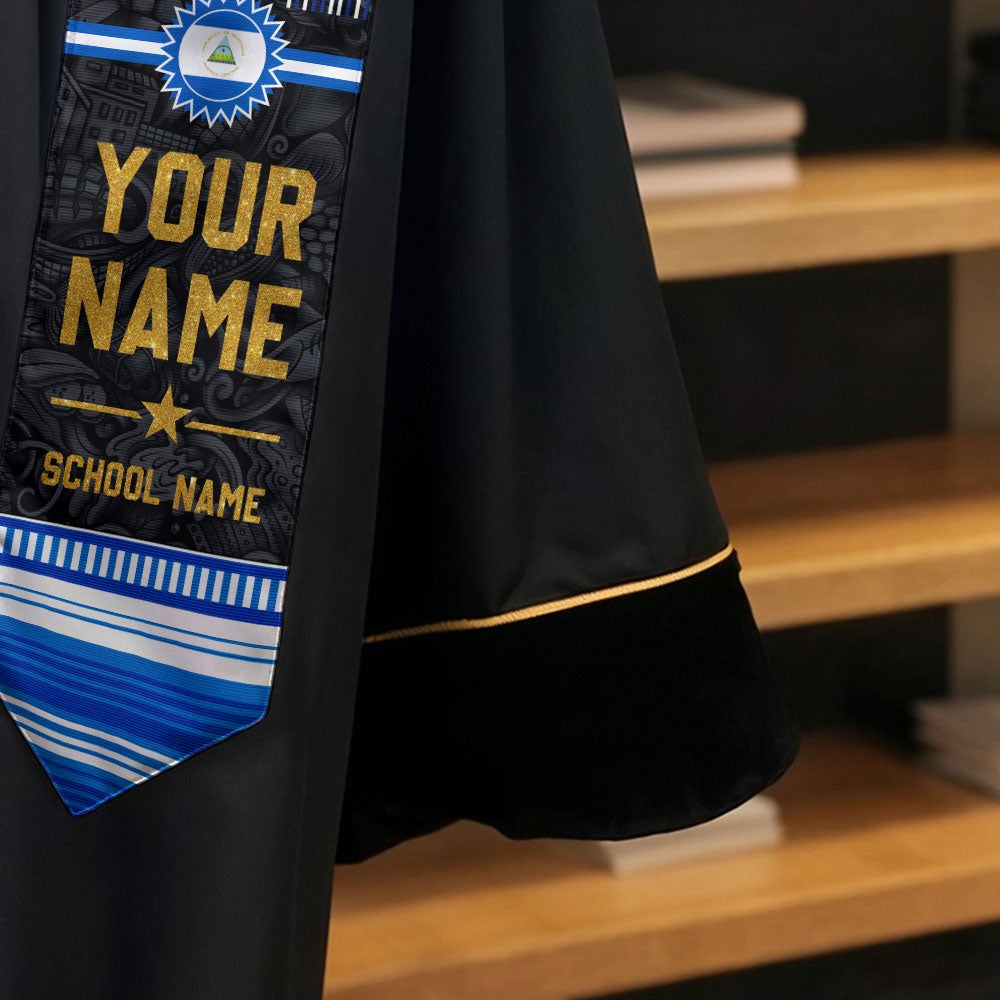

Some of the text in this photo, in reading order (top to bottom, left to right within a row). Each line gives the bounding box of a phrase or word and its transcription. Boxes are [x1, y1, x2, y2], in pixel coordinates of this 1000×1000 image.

[97, 142, 317, 261] YOUR
[60, 256, 302, 380] NAME
[41, 451, 265, 524] SCHOOL NAME
